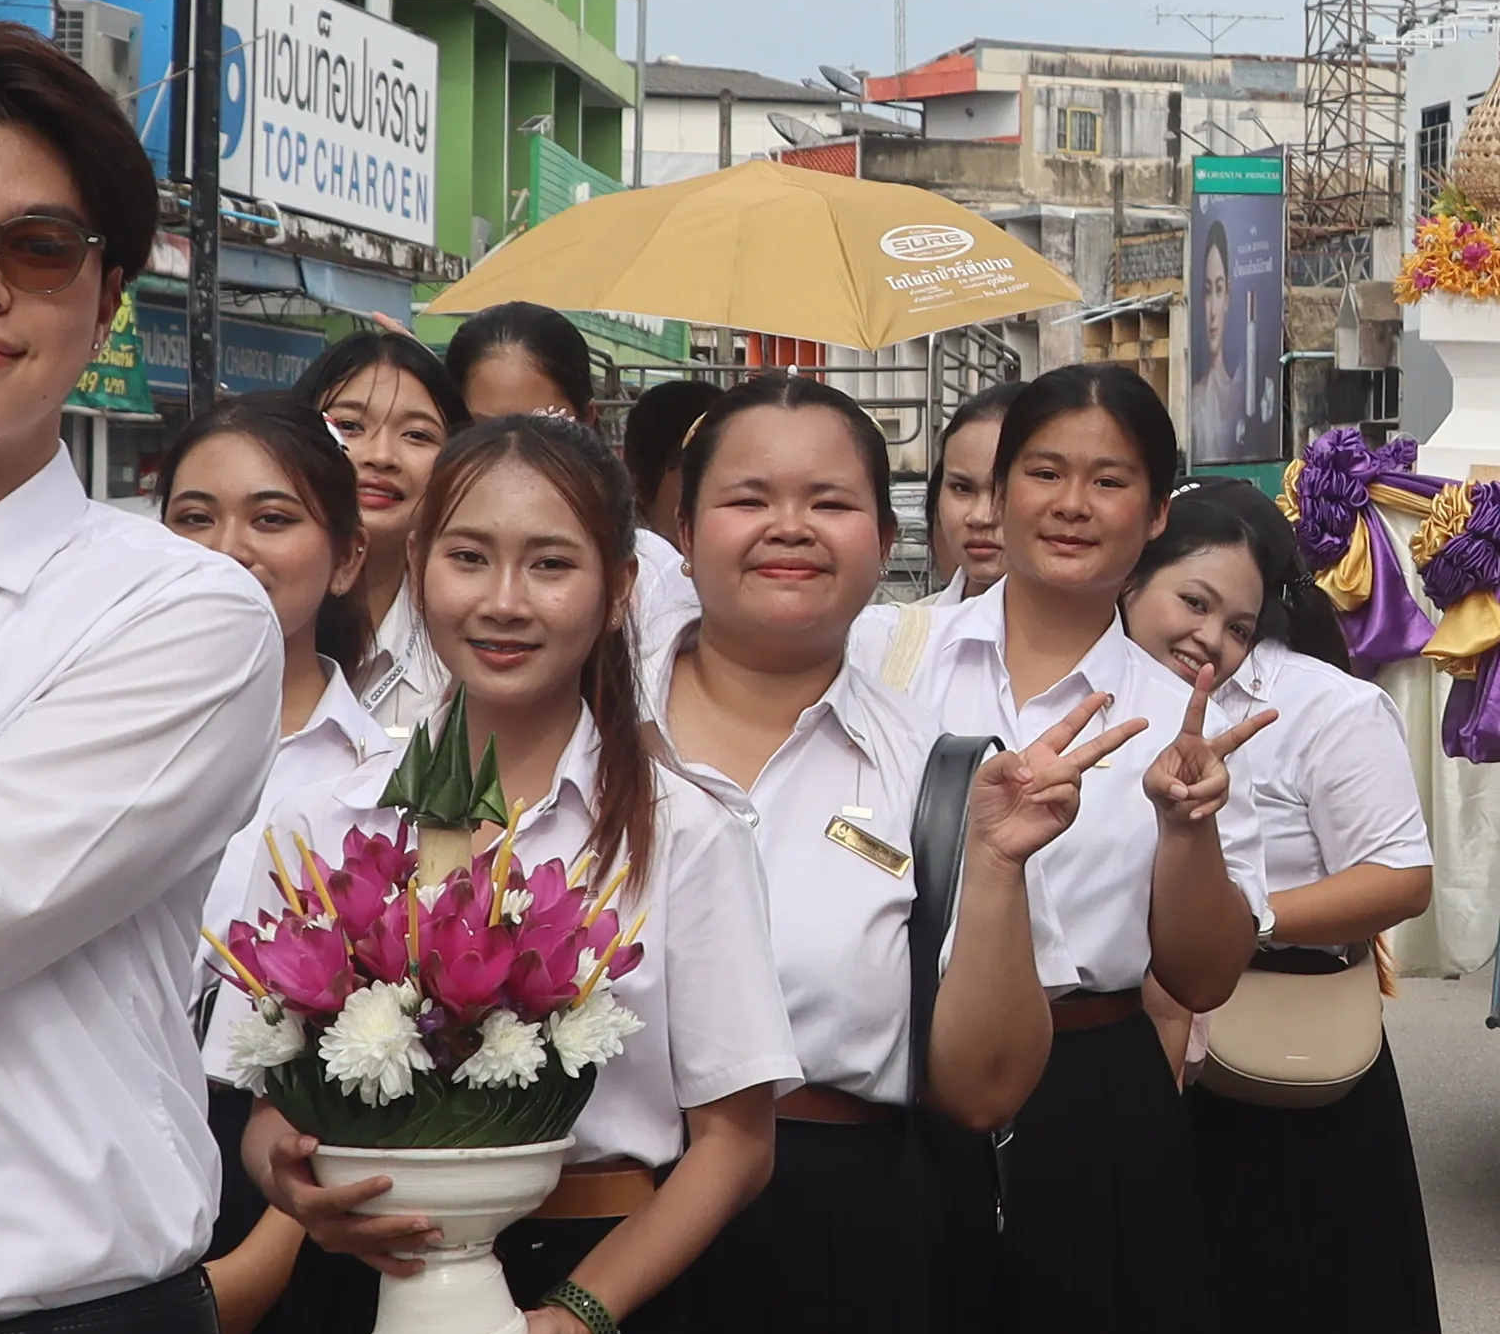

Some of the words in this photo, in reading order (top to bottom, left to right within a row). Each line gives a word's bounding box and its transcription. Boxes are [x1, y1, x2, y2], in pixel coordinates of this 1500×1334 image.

[262, 3, 429, 155] แว่นท็อปเจริญ
[262, 120, 308, 186] TOP
[313, 137, 428, 225] CHAROEN
